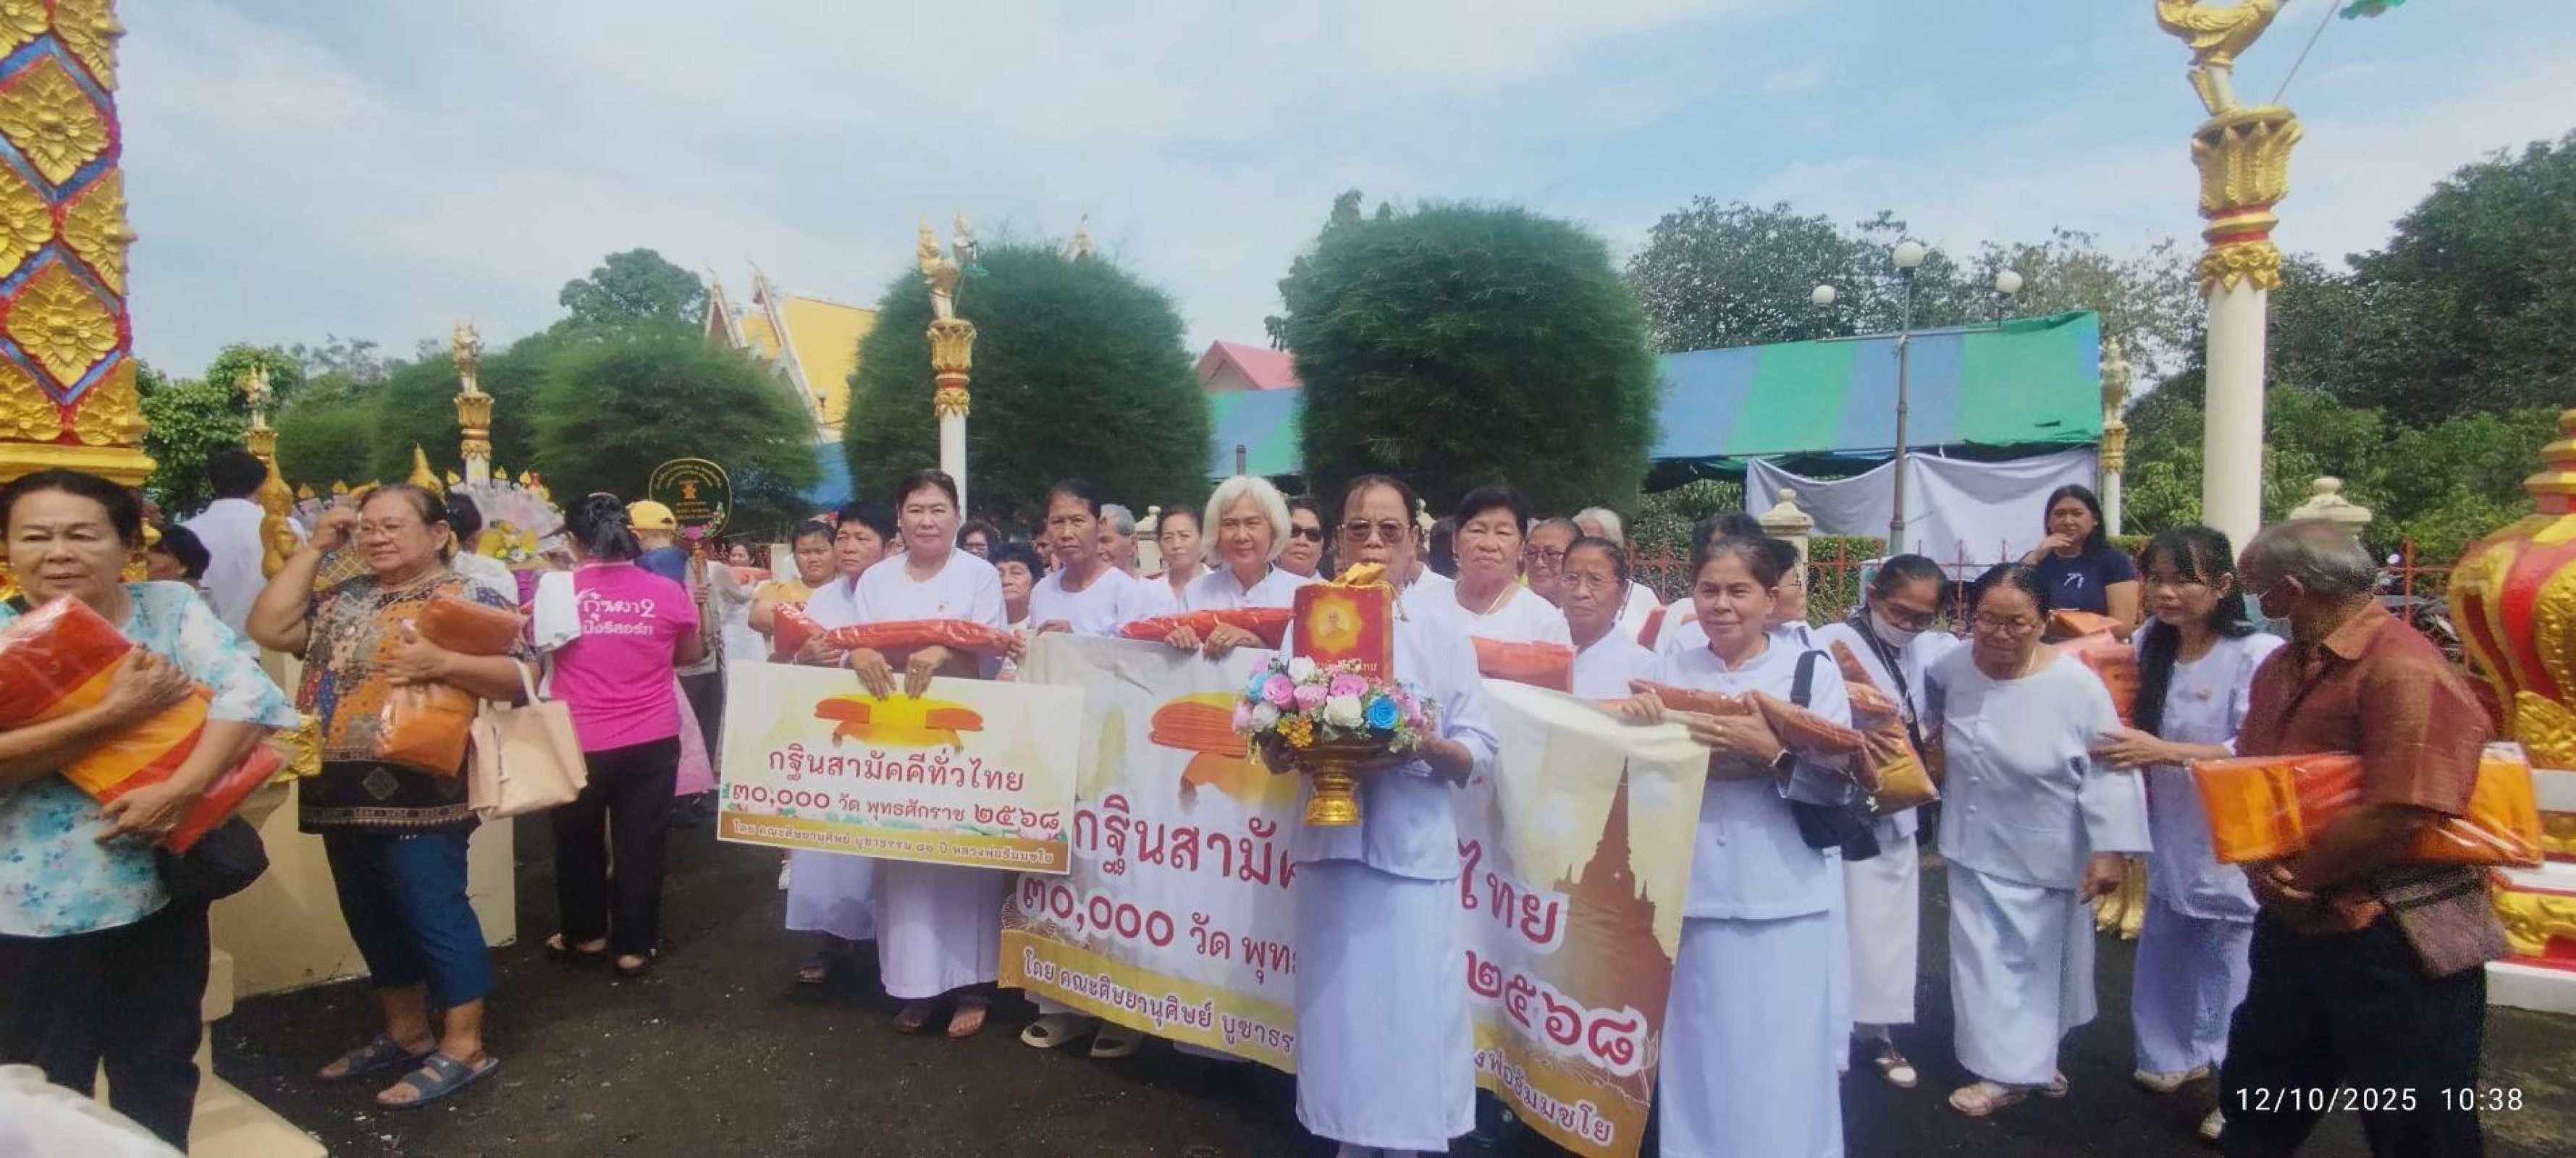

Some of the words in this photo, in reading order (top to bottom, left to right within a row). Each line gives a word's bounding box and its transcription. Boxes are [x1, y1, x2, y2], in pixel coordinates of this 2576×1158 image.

[733, 782, 830, 810] ๓๐,๐๐๐
[838, 795, 859, 812] วัด
[974, 803, 1059, 830] ๒๕๖๘
[769, 743, 1024, 793] กฐินสามัคคีทั่วไทย
[1458, 839, 1559, 944] ไทย
[1022, 876, 1174, 947] ๓๐,๐๐๐
[1190, 912, 1231, 960] วัด
[1242, 937, 1296, 984] พุท
[1465, 950, 1638, 1065] ๒๕๖๘
[1024, 950, 1055, 981] โดย
[1060, 971, 1213, 1027] คณะศิษยานุศิษย์
